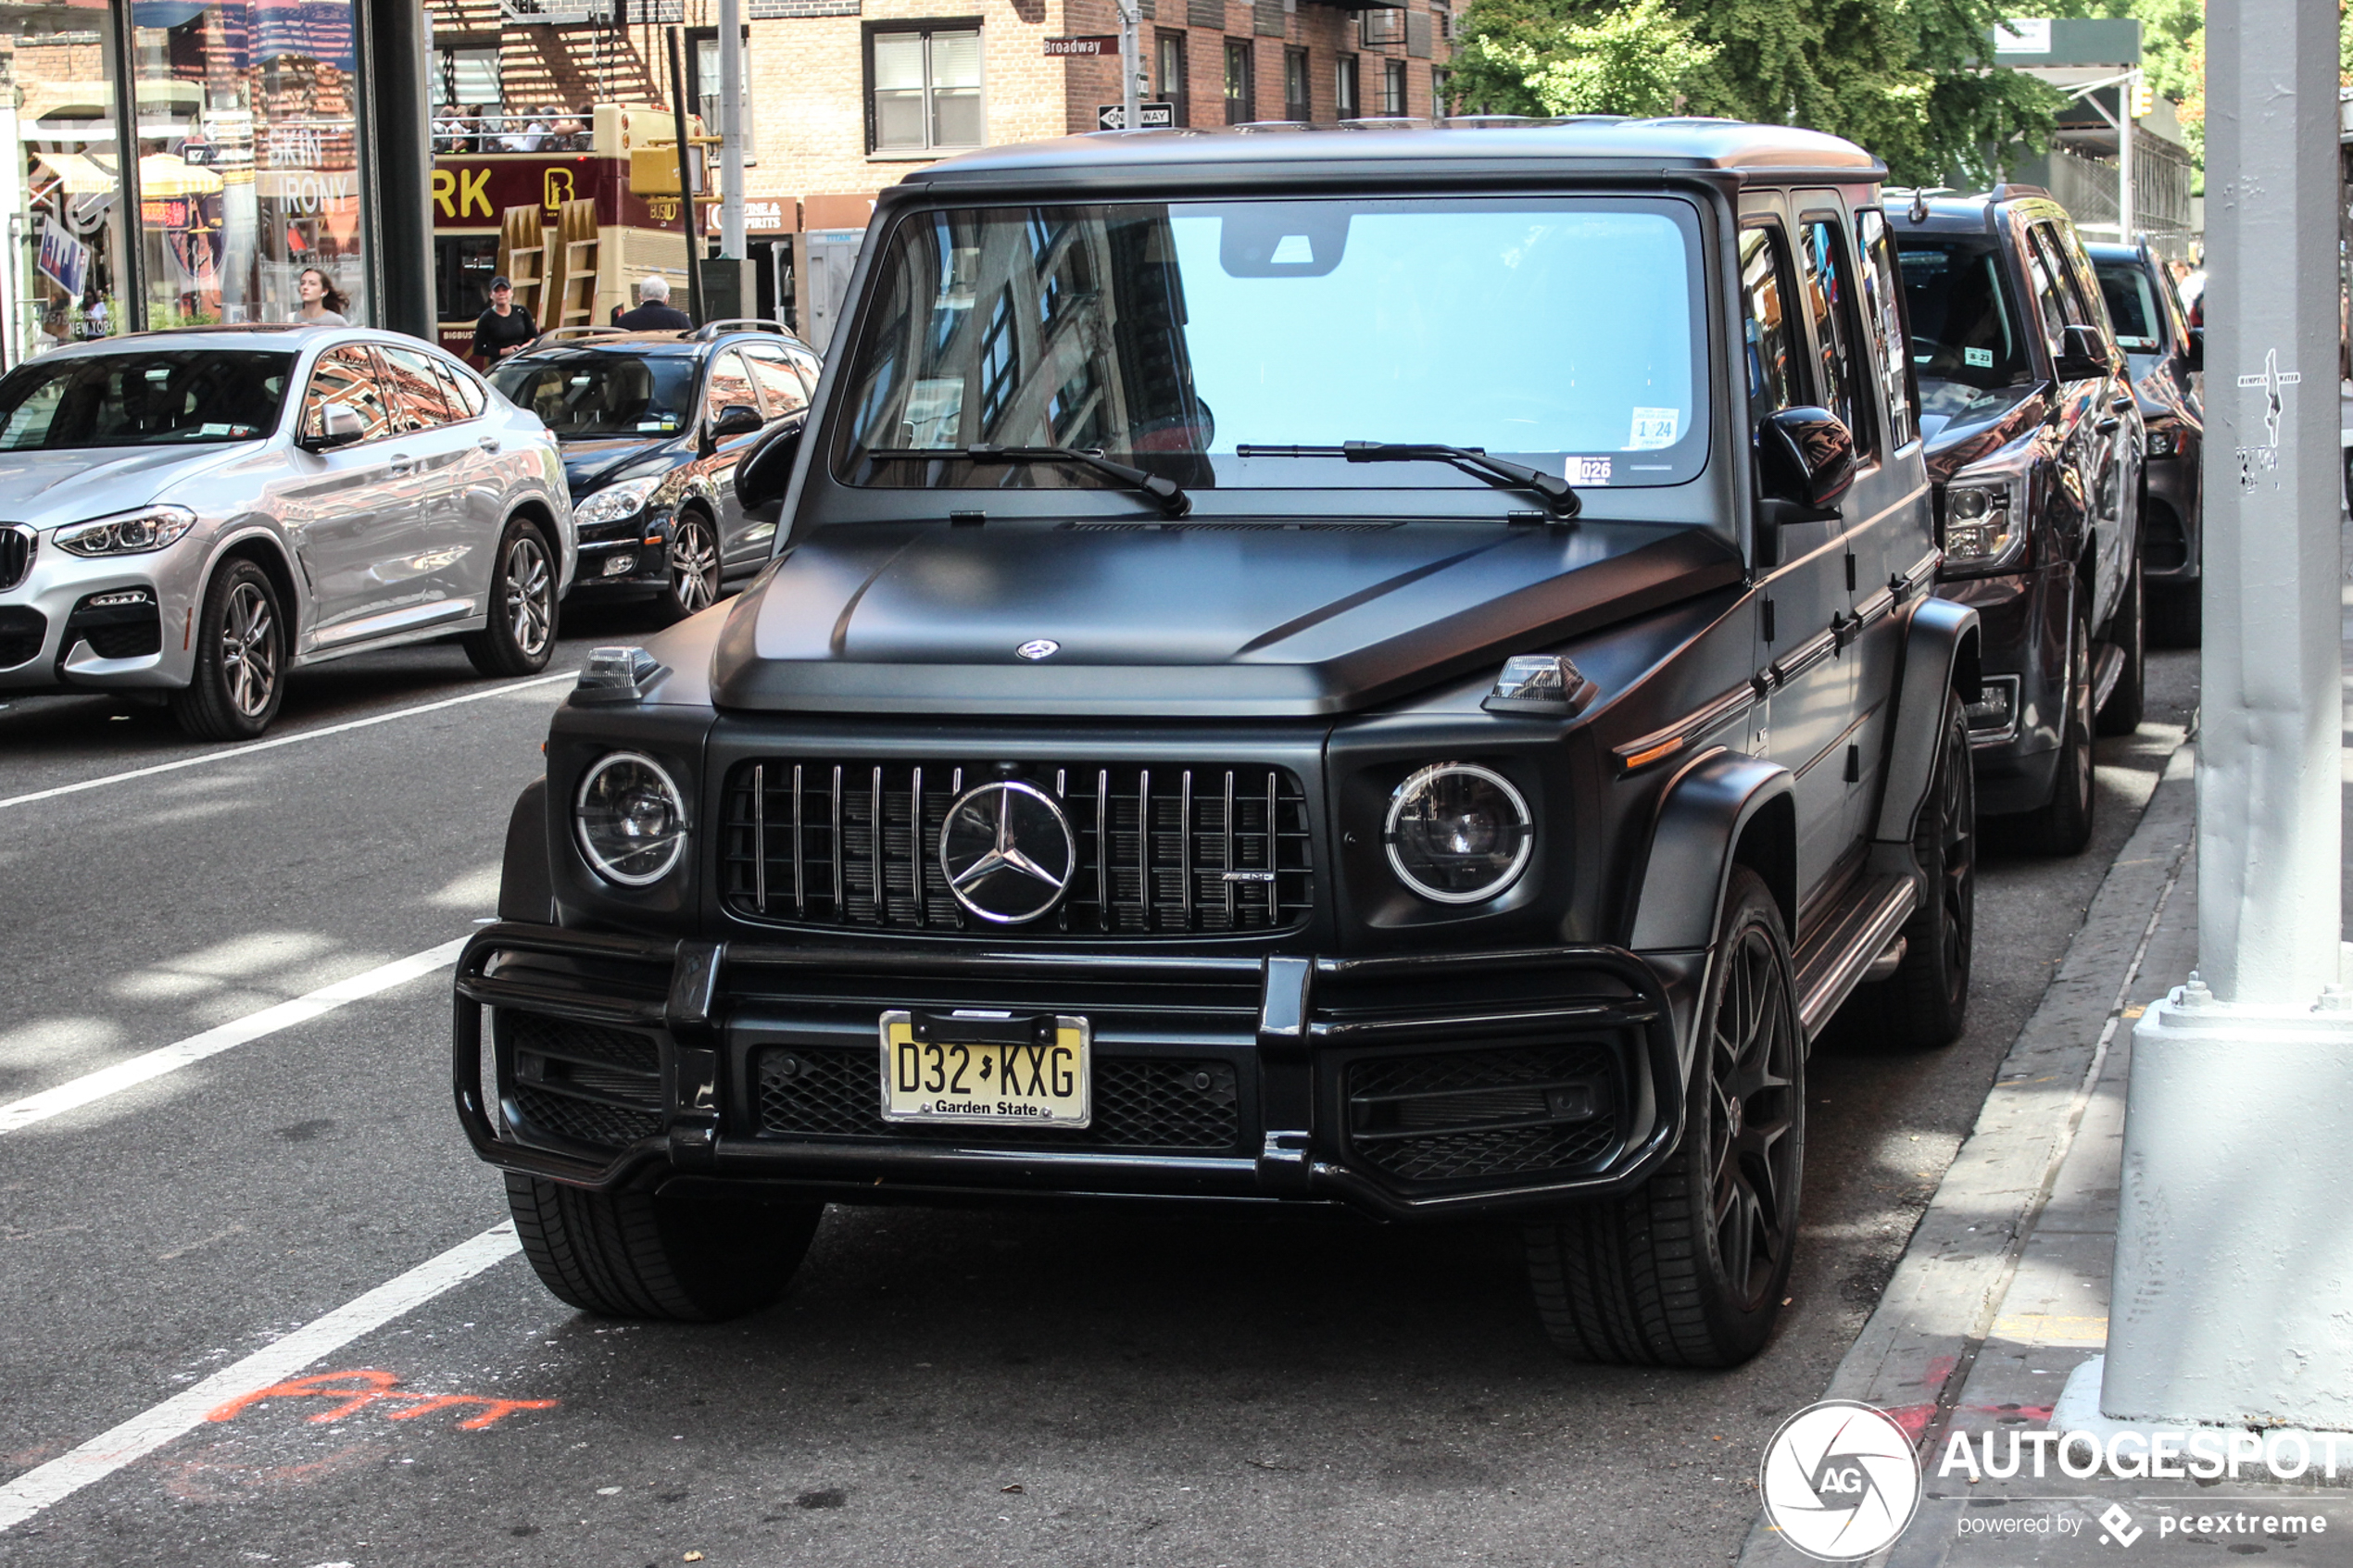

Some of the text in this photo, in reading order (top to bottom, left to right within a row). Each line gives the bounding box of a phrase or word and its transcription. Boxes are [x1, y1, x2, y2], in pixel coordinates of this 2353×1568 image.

[1044, 40, 1101, 55] Broadway
[1108, 110, 1167, 122] ON WAY
[269, 129, 322, 167] SKIN
[279, 176, 348, 214] IRONY
[744, 217, 781, 230] PIRITS
[69, 320, 115, 336] NEW YORK
[1655, 420, 1672, 437] 24
[1581, 461, 1612, 479] 026
[898, 1042, 1074, 1098] D32 KXG
[936, 1099, 1038, 1116] Garden State
